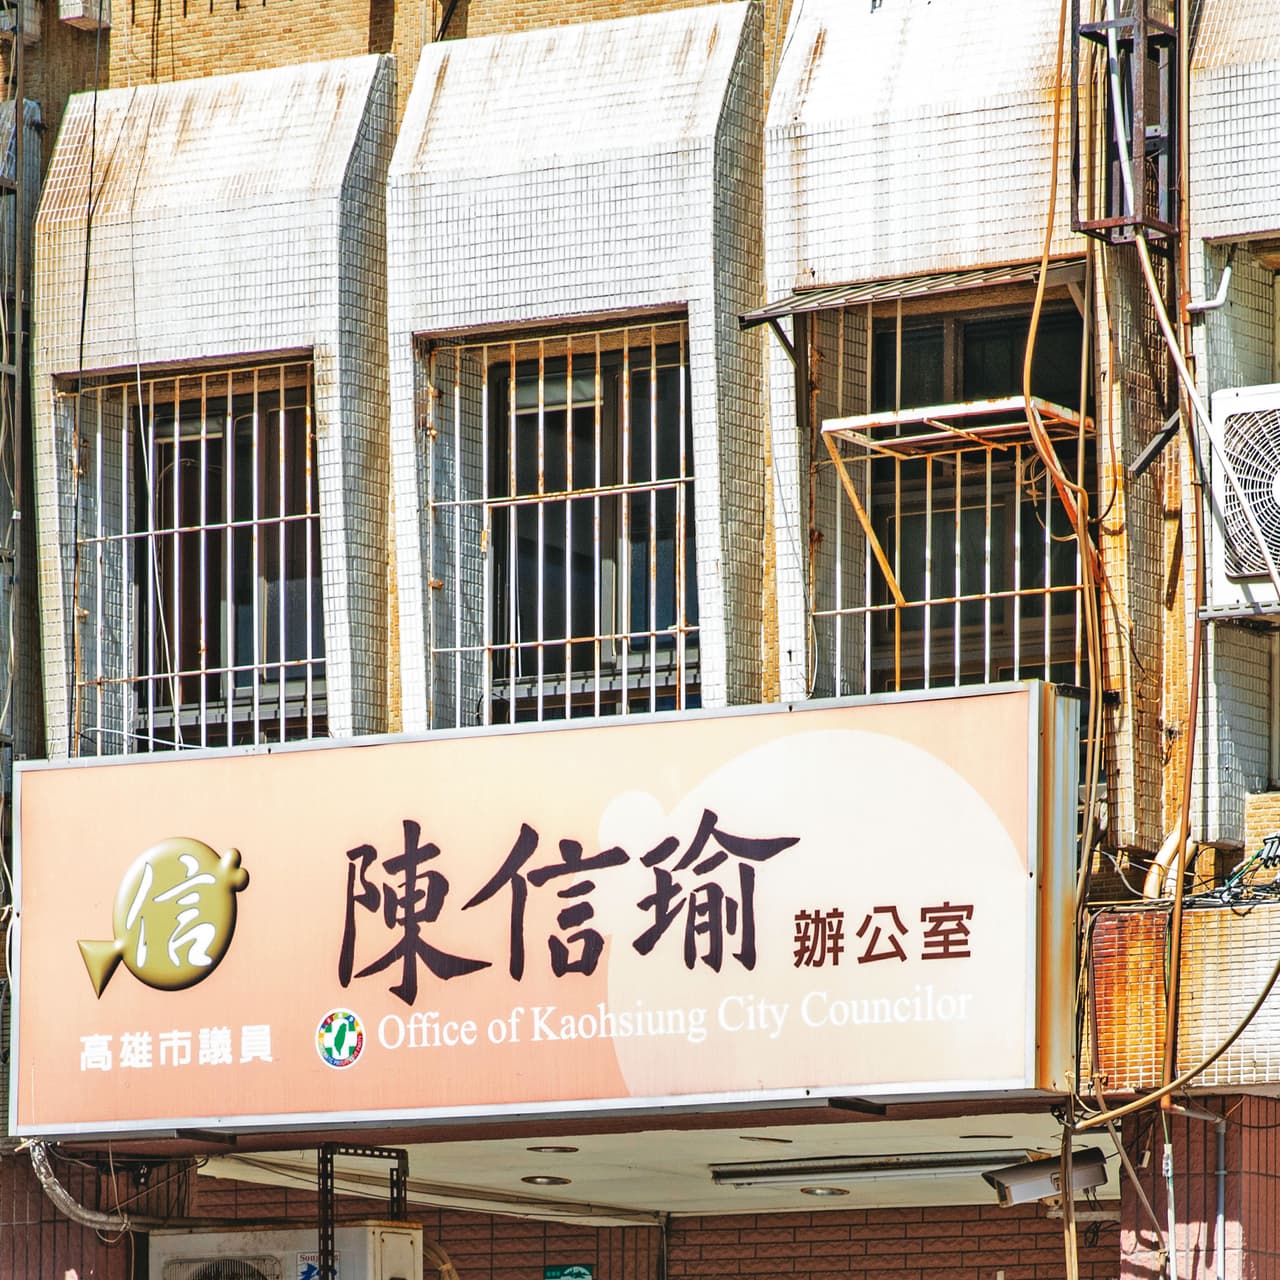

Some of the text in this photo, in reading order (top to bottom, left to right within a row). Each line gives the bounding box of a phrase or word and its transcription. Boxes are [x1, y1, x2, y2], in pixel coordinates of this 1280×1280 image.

[126, 854, 217, 968] 信
[338, 808, 975, 1007] 陳信瑜 辦公室
[80, 1024, 273, 1072] 高雄市議員
[378, 1011, 478, 1049] Office
[487, 1007, 525, 1044] of
[531, 1001, 707, 1043] Kaohsiung
[719, 992, 789, 1040] City
[801, 986, 974, 1029] Councilor
